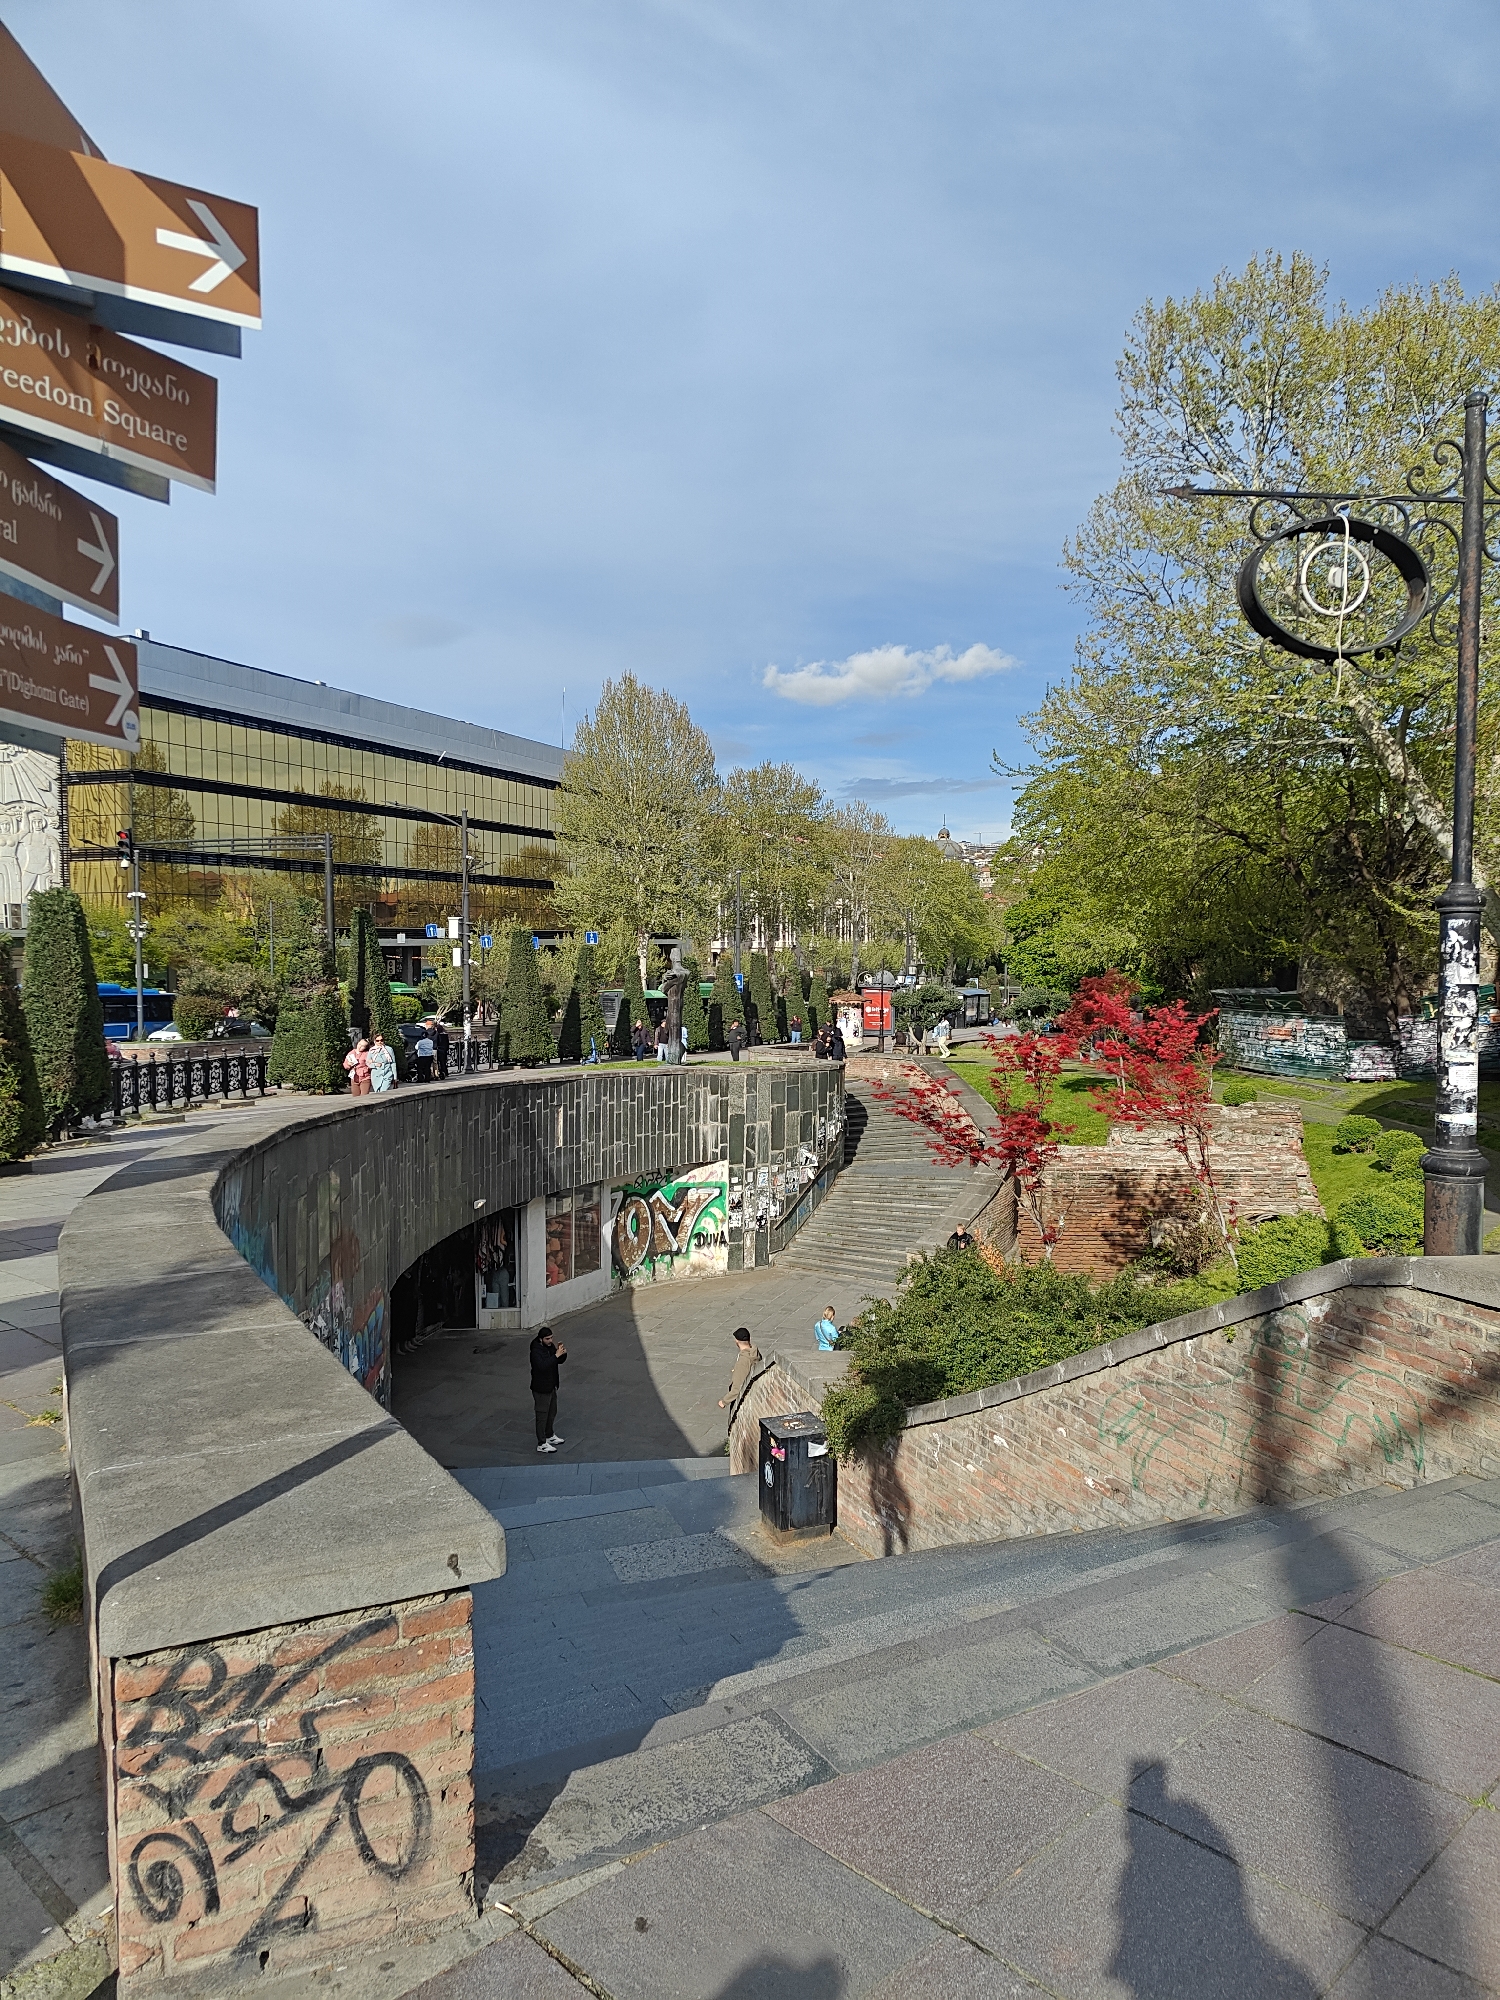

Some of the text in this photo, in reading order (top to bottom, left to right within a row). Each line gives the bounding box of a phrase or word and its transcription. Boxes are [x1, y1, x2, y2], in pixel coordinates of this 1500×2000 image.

[0, 313, 71, 358] ების
[0, 366, 188, 452] eedom Square
[59, 688, 90, 716] Gate)
